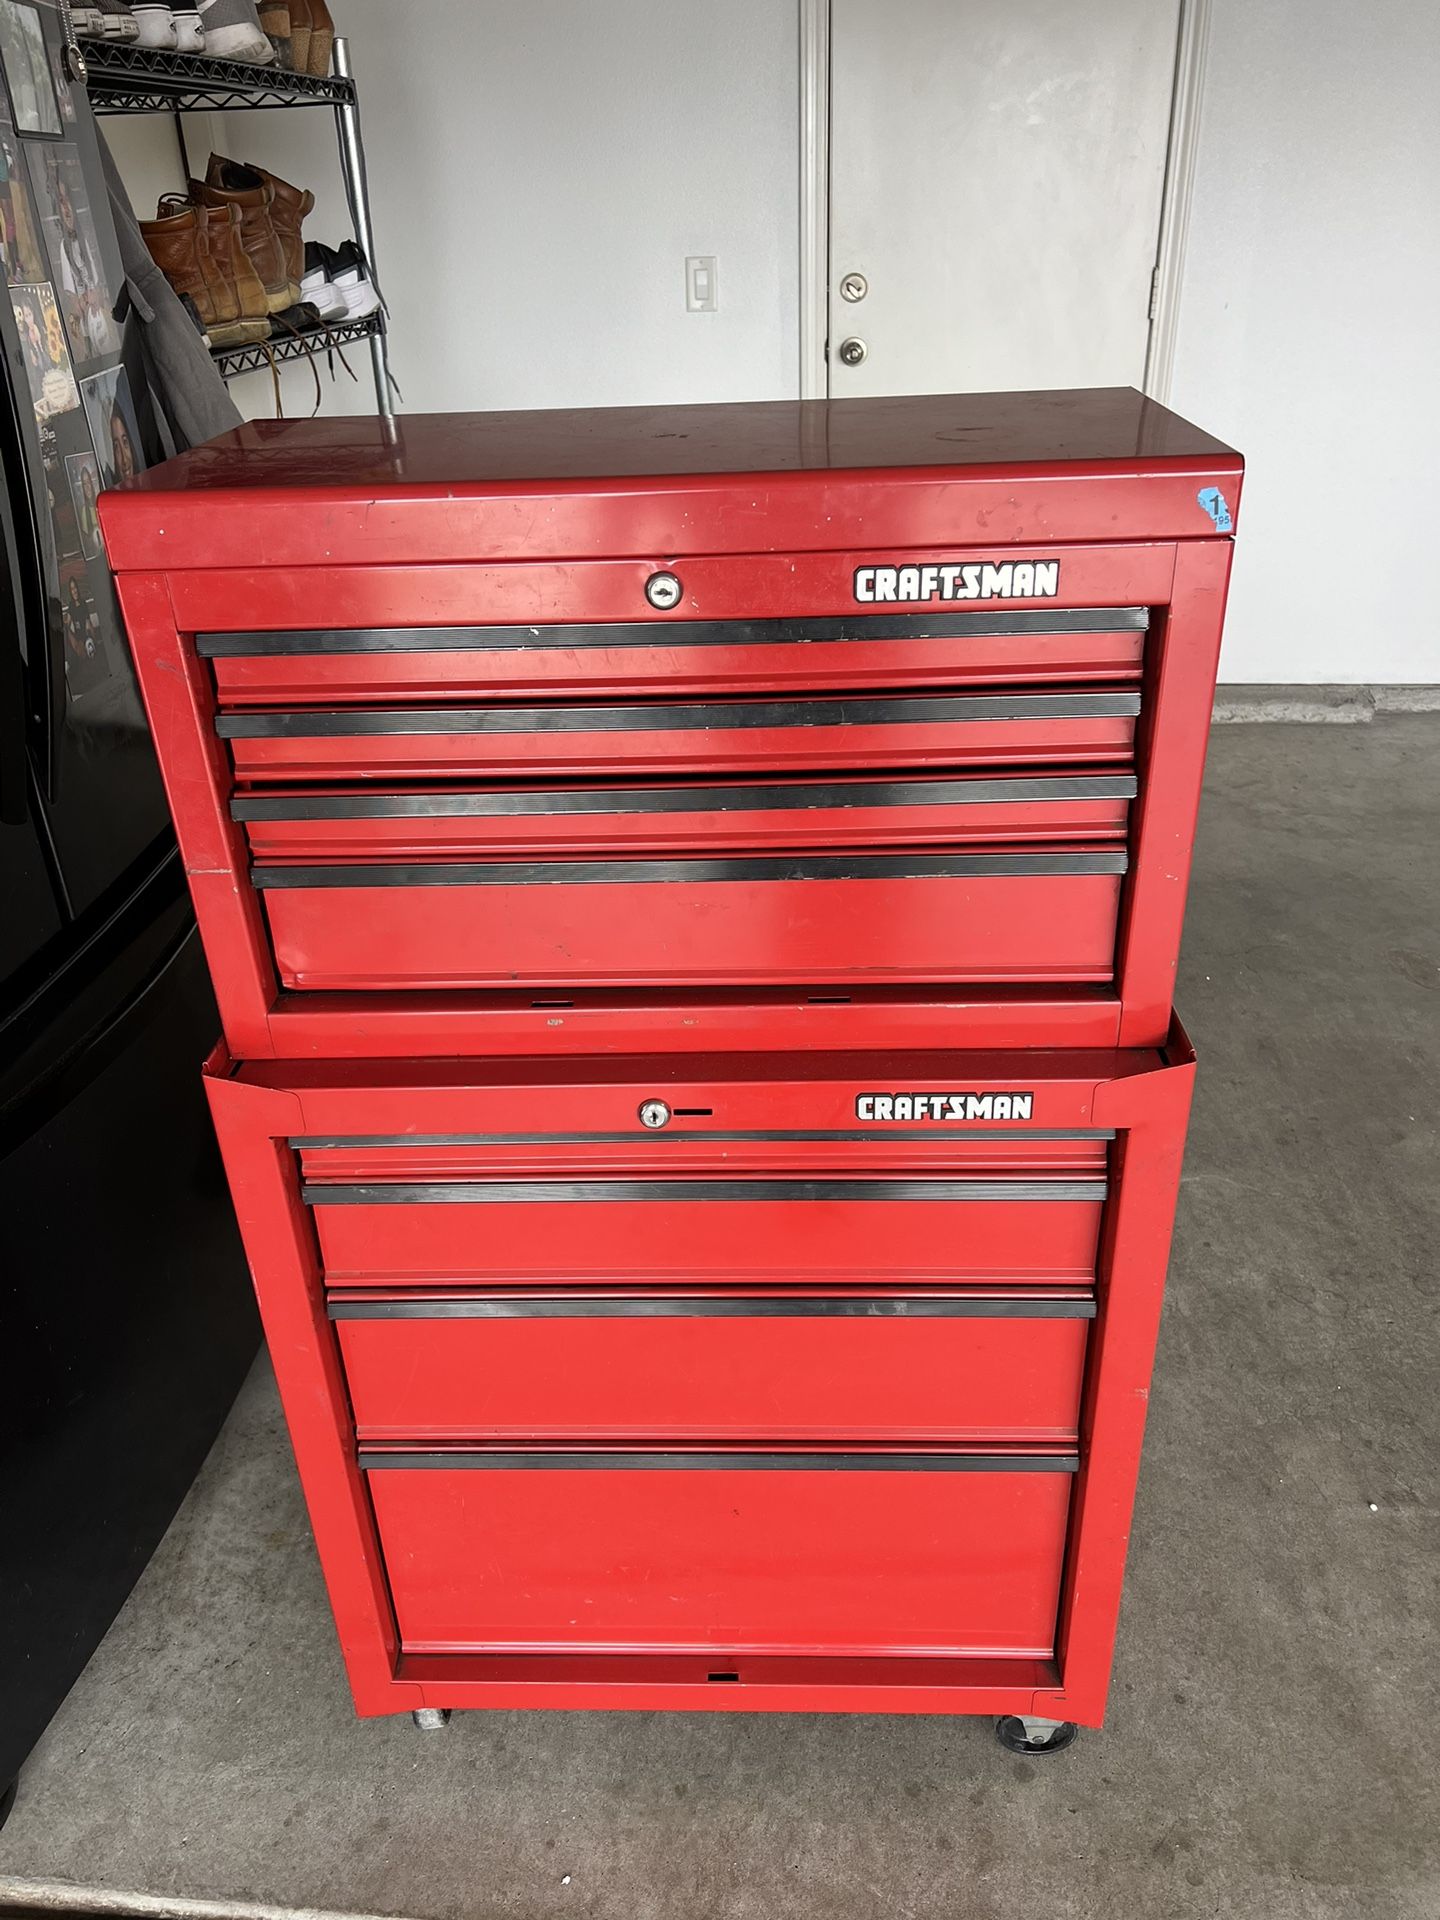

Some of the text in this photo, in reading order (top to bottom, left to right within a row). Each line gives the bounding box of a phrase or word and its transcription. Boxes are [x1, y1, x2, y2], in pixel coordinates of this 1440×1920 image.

[1209, 494, 1220, 516] 1
[855, 560, 1059, 602] CRAFTSMAN
[856, 1093, 1034, 1120] CRAFTSMAN
